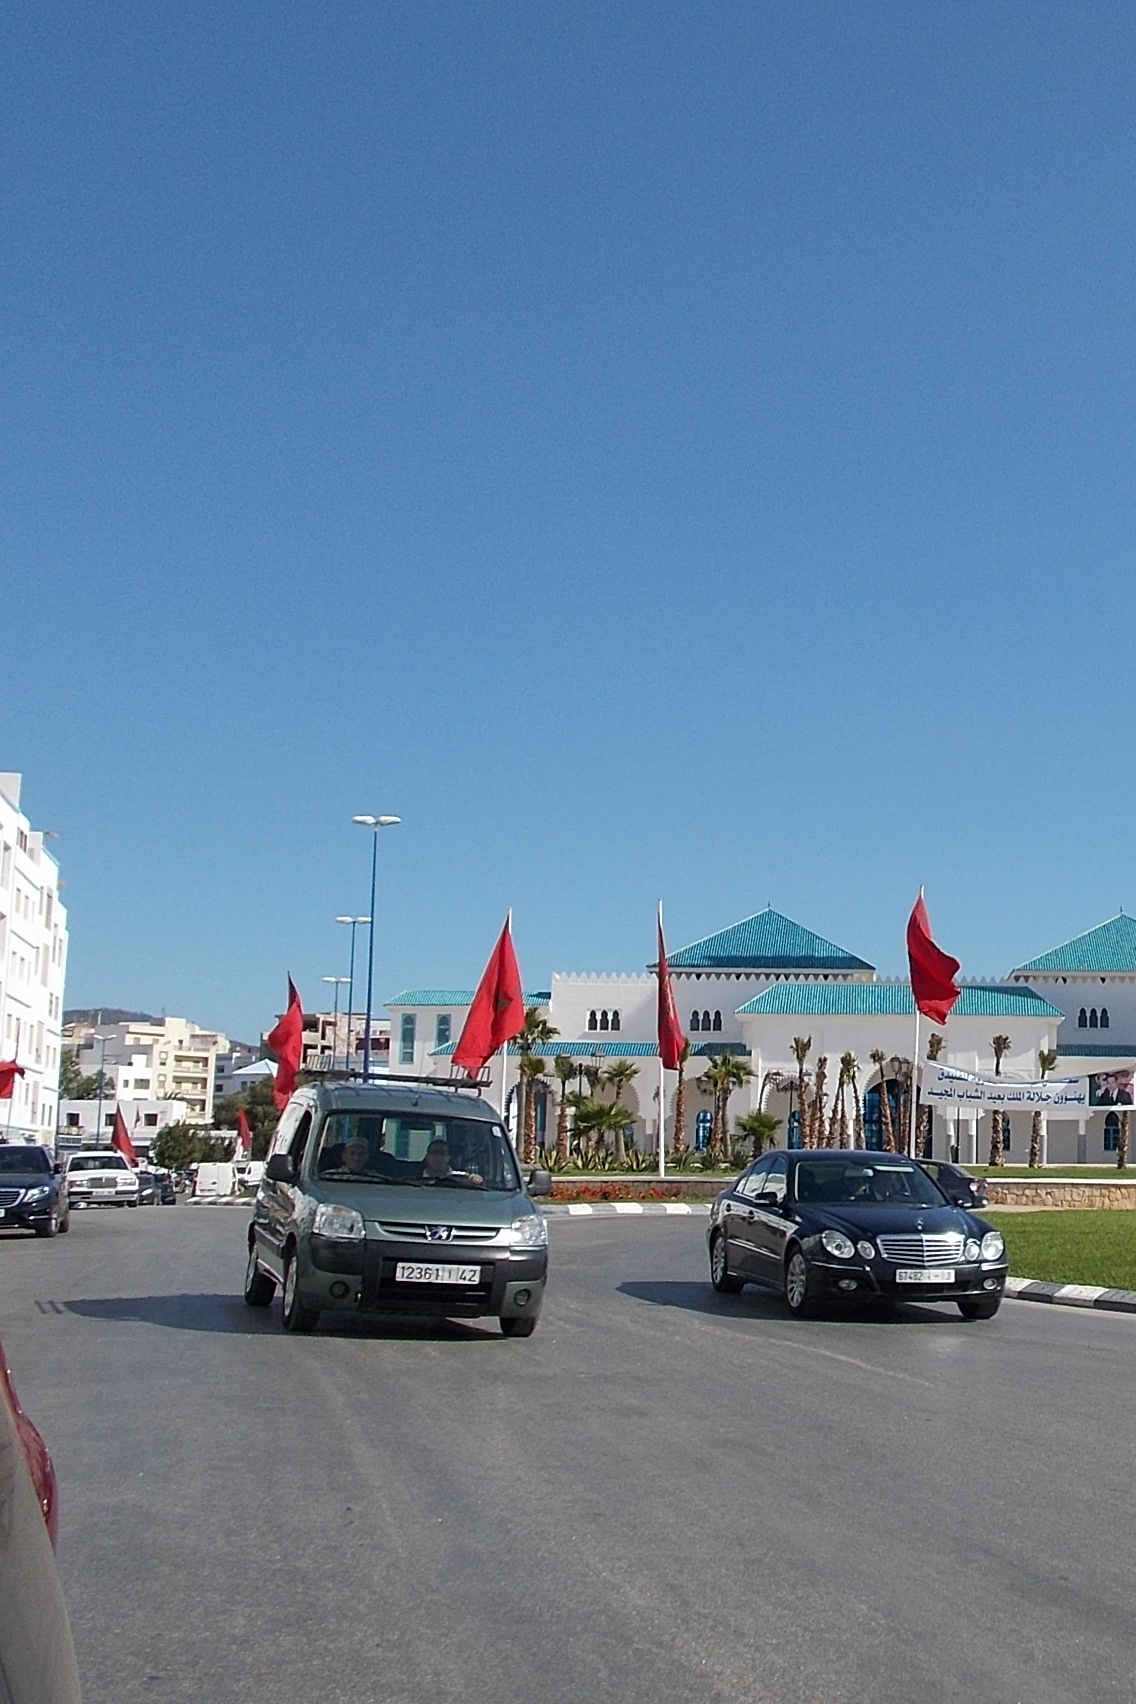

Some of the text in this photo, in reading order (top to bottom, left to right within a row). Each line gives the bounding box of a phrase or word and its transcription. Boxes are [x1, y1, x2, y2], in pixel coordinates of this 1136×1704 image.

[957, 1087, 985, 1102] الشباب
[987, 1092, 1005, 1104] بعيد
[1006, 1090, 1025, 1102] الملك
[1026, 1090, 1052, 1105] جلالة
[400, 1266, 440, 1281] 12361
[459, 1269, 477, 1282] 42
